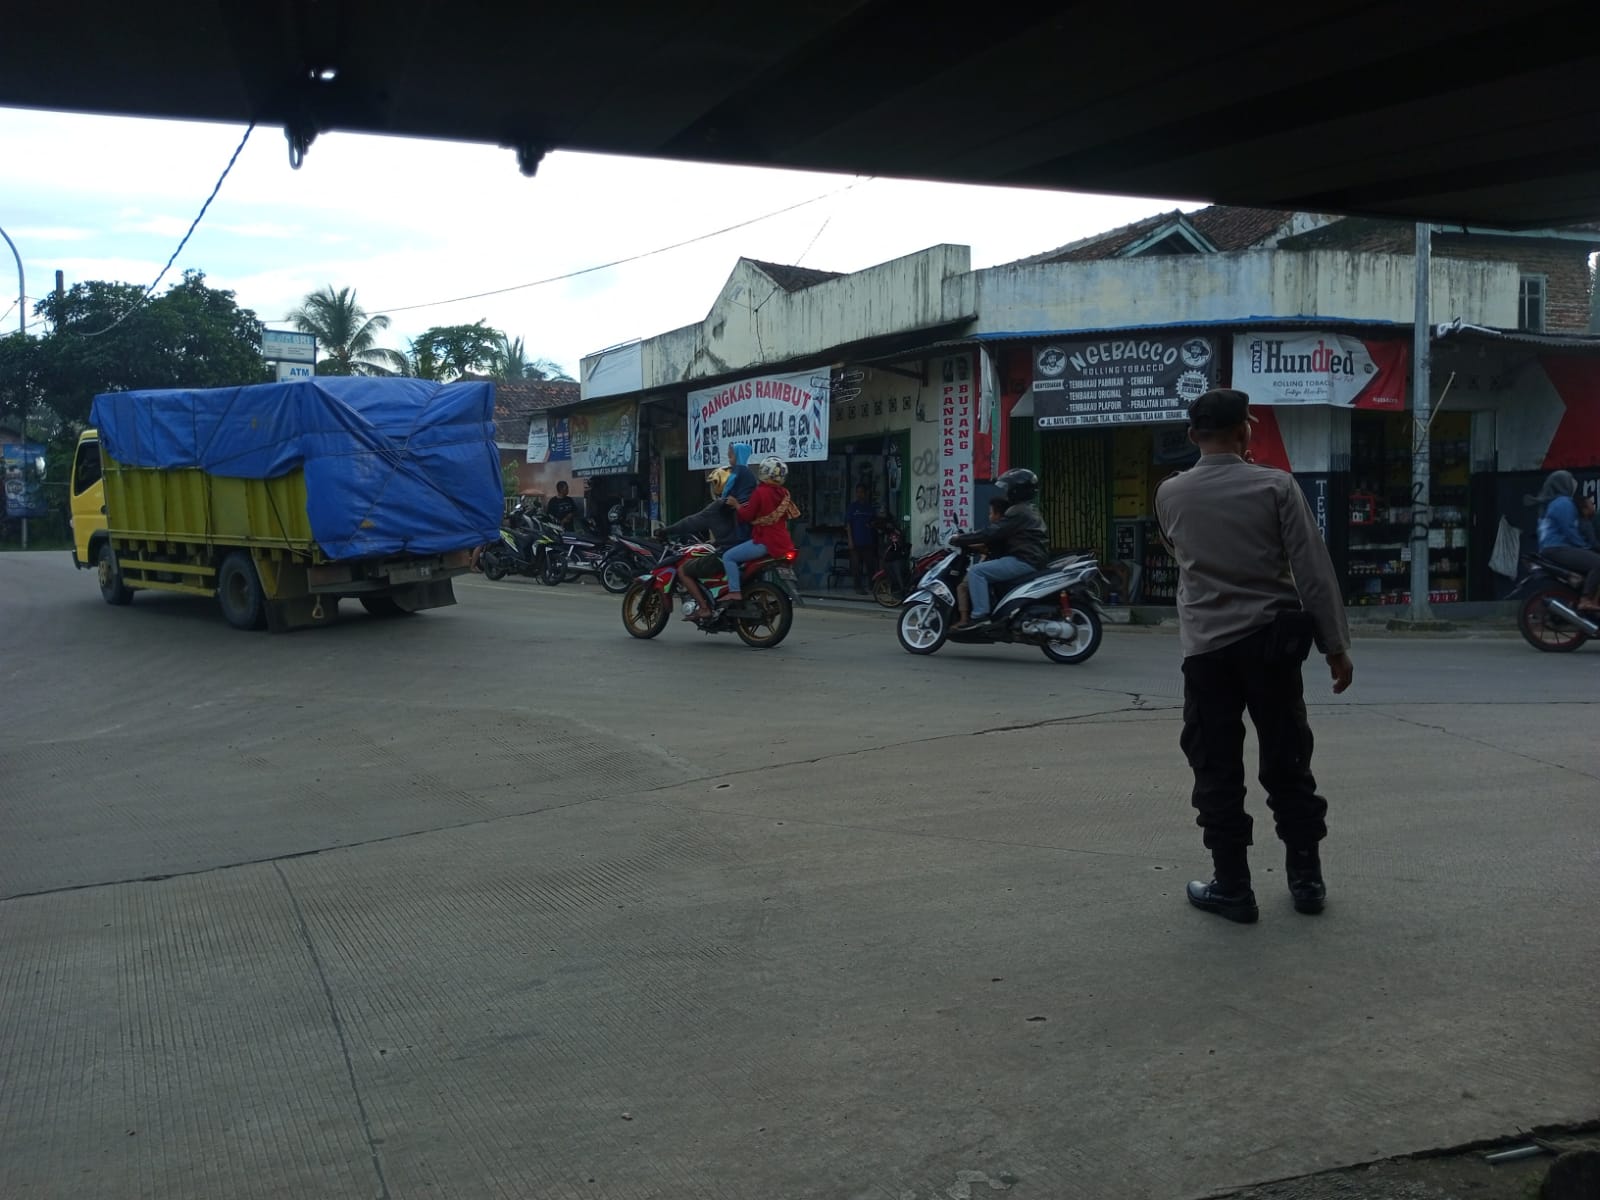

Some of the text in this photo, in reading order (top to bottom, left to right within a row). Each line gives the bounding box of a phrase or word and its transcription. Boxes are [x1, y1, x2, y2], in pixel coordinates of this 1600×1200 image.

[1069, 340, 1178, 371] NGEBACCO
[1264, 339, 1354, 376] Hundred
[290, 367, 310, 377] ATM
[1083, 363, 1164, 376] ROLLING TOBACCO
[1069, 378, 1097, 389] TEMBAKAU
[1273, 380, 1304, 388] ROLLING
[1069, 389, 1122, 401] TEMBAKAU ORIGINAL
[1130, 386, 1165, 397] ANEKA PAPER
[701, 380, 812, 422] PANGKAS RAMBUT
[1069, 400, 1122, 412] TEMBAKAU PLAFOUR
[1130, 398, 1159, 409] PERALATAN
[721, 414, 751, 439] BUJANG
[941, 386, 956, 528] PANGKAS RAMBUT
[958, 384, 969, 528] BUJANG PALALA
